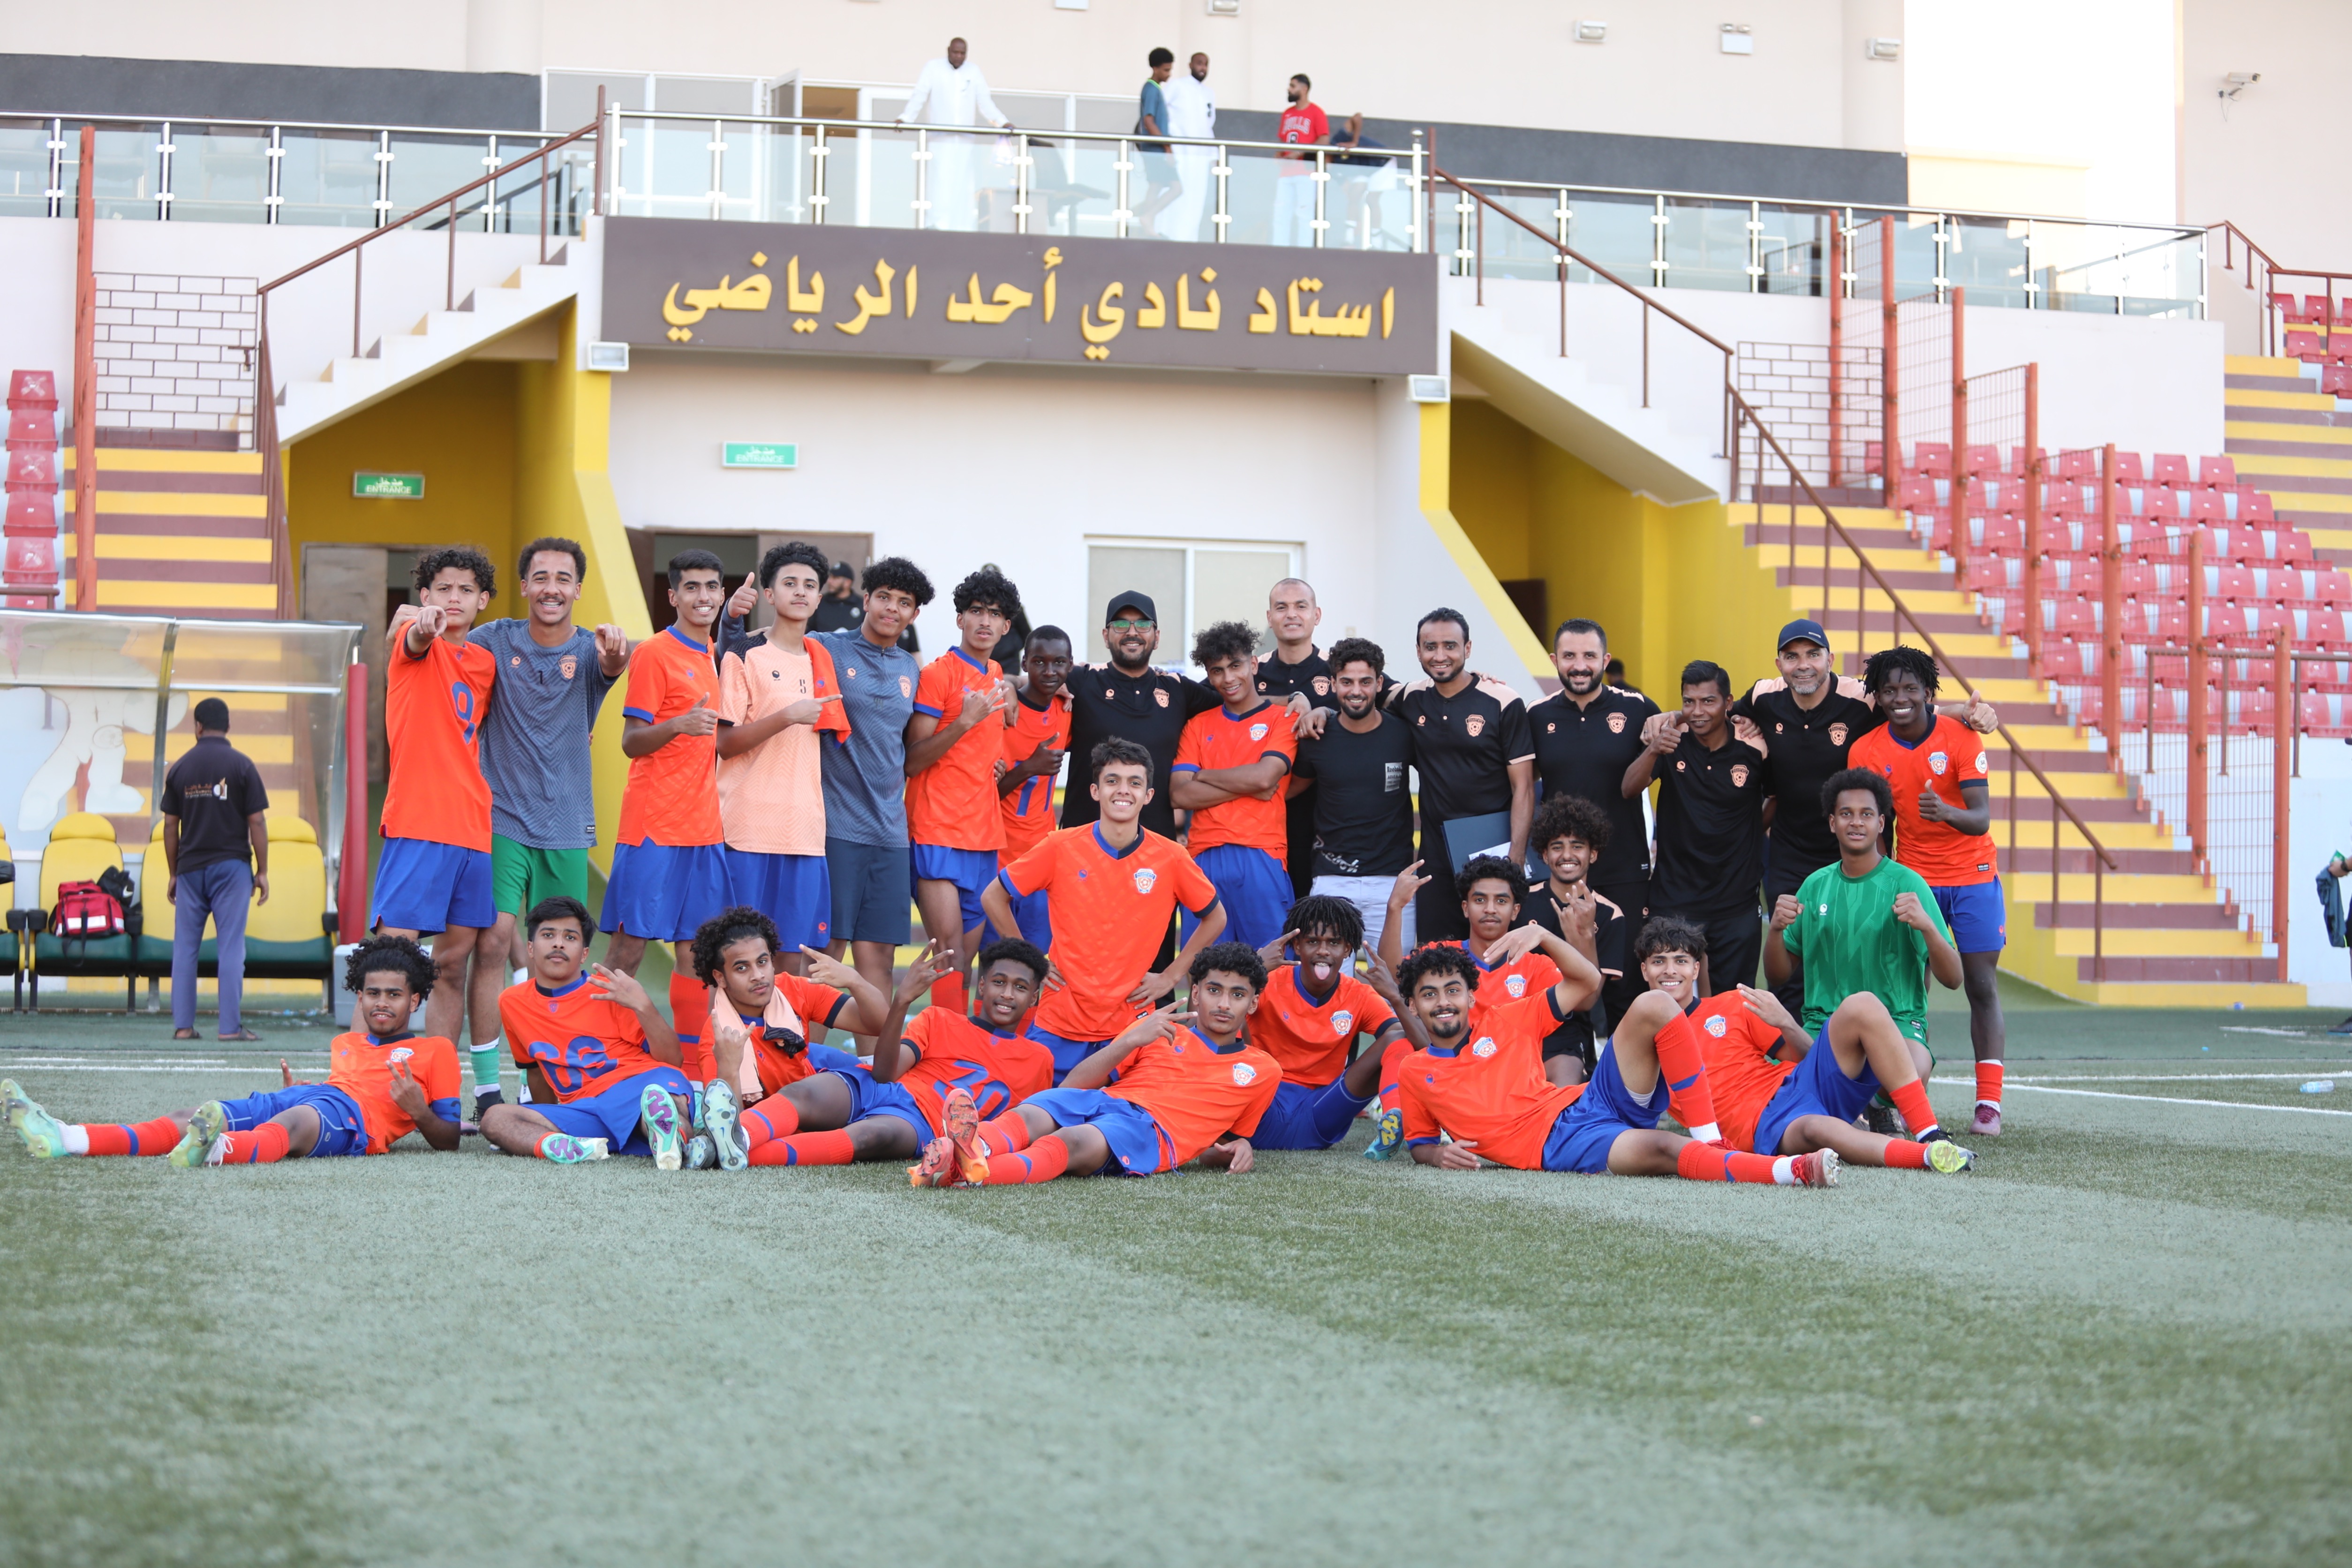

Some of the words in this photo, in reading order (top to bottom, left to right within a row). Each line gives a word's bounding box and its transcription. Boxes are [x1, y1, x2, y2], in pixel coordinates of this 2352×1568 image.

[662, 251, 918, 343] الرياضي
[945, 246, 1063, 324] أحد
[1079, 267, 1221, 361] نادي
[1248, 277, 1395, 339] استاد
[365, 484, 412, 494] ENTRANCE
[735, 453, 784, 463] ENTRANCE
[539, 671, 543, 684] 1
[799, 679, 807, 694] 5
[452, 681, 475, 745] 9
